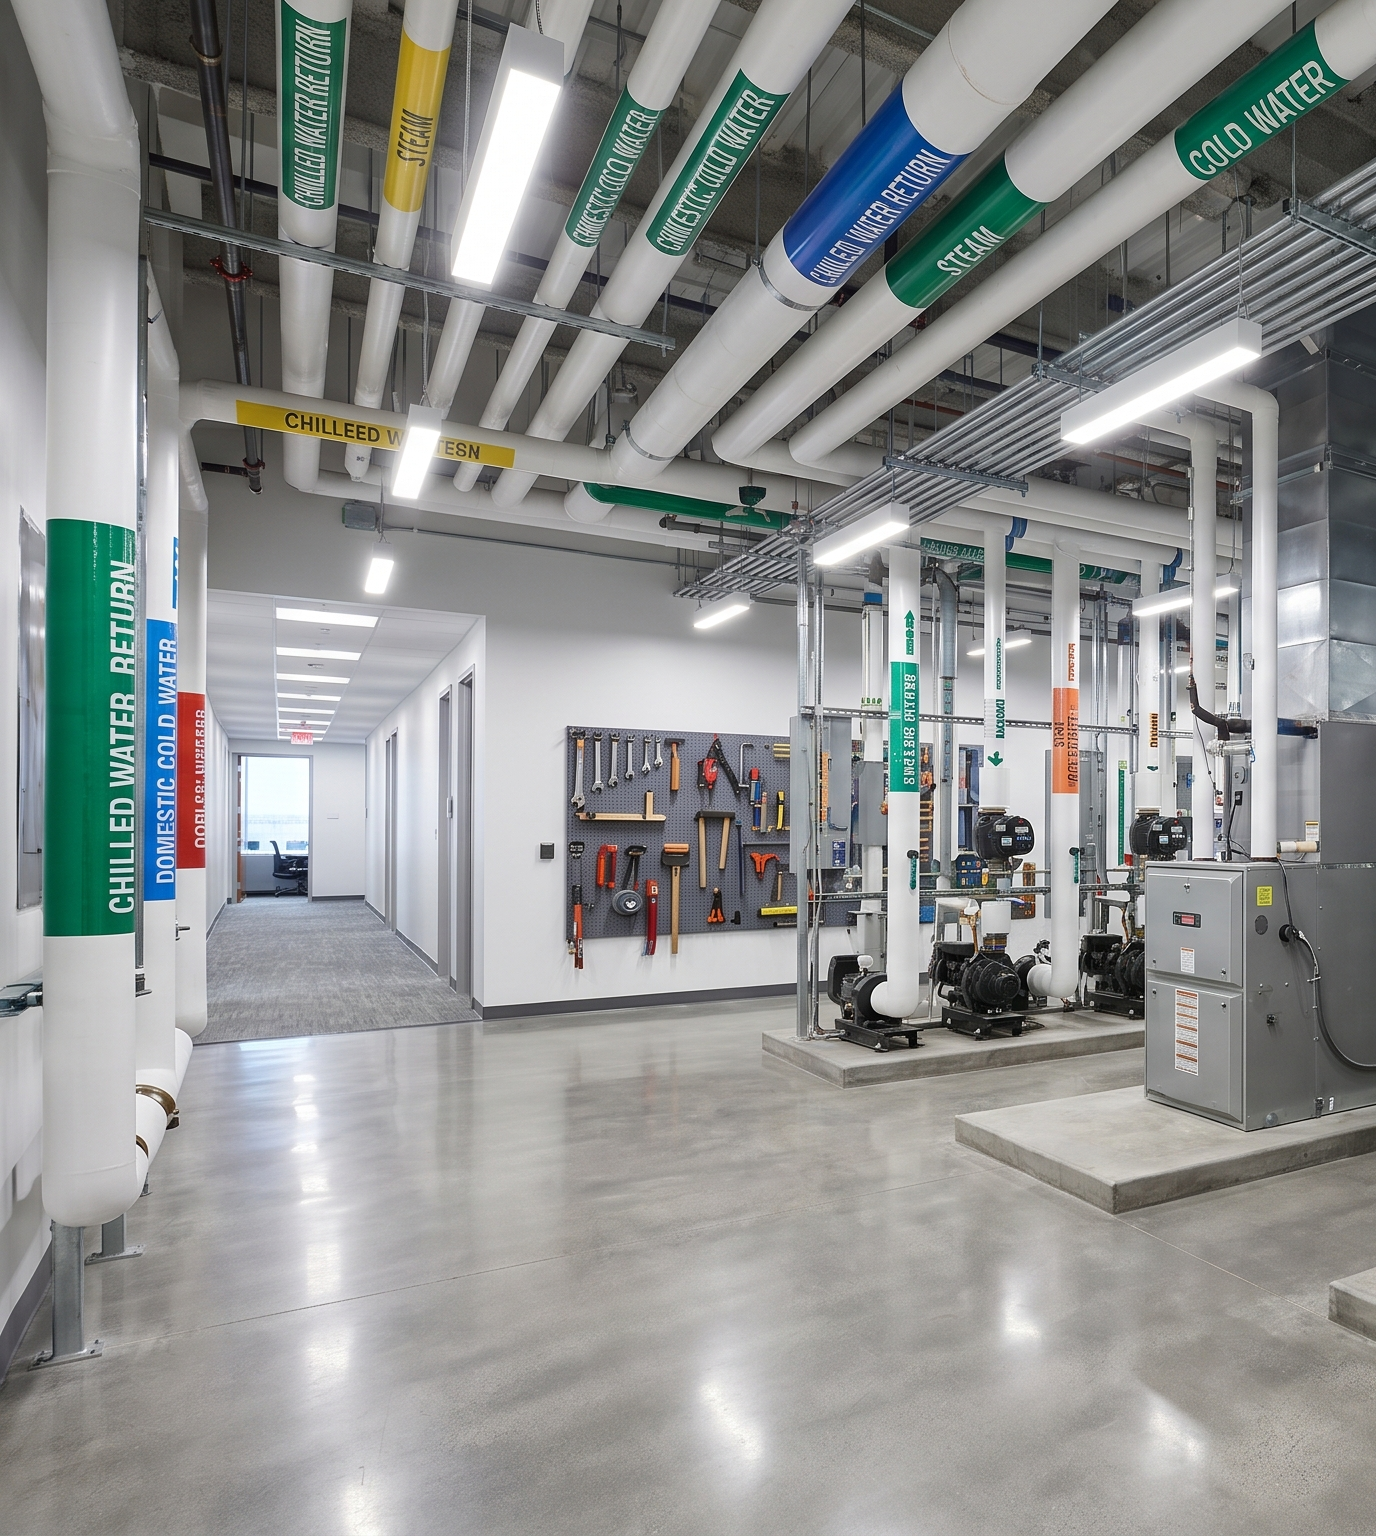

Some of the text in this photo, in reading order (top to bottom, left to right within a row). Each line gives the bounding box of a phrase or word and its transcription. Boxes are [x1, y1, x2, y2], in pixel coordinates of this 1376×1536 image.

[295, 19, 332, 96] RETURN
[295, 92, 328, 149] WATER
[397, 108, 433, 167] STEAM
[716, 89, 775, 150] WATER
[1188, 58, 1337, 176] COLD WATER
[881, 149, 950, 206] RETURN
[937, 225, 1005, 278] STEAM
[285, 412, 380, 442] CHILLEED
[109, 560, 136, 676] RETURN
[109, 692, 136, 789] WATER
[156, 637, 178, 884] DOMESTIC COLD WATER
[109, 797, 135, 915] CHILLED
